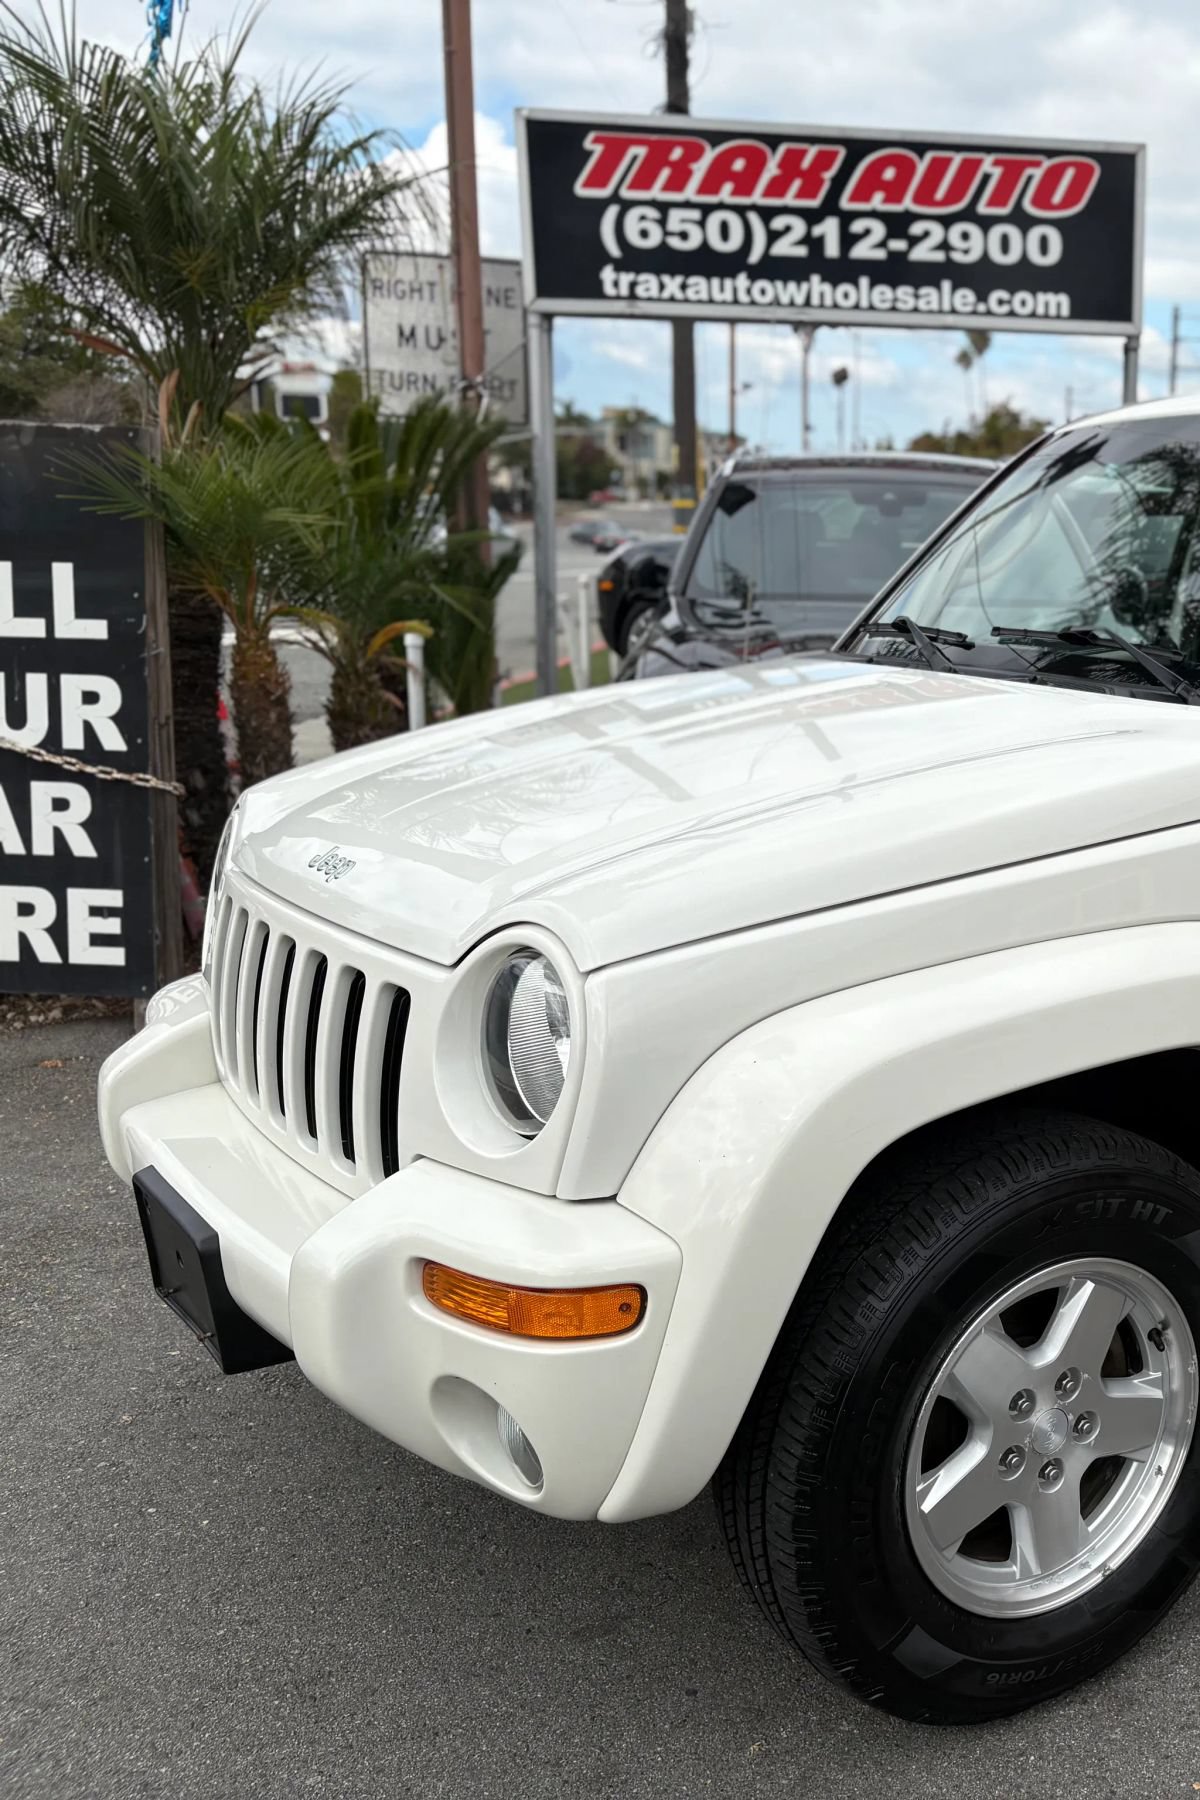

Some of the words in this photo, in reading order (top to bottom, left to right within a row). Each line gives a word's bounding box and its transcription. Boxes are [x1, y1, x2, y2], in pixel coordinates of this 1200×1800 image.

[573, 131, 846, 202] TRAX
[842, 148, 1101, 217] AUTO
[599, 204, 1064, 267] (650)212-2900
[371, 278, 437, 303] RIGHT
[599, 264, 1071, 318] traxautowholesale.com
[376, 369, 437, 393] TURN
[308, 846, 356, 883] Jeep
[0, 885, 126, 967] RE
